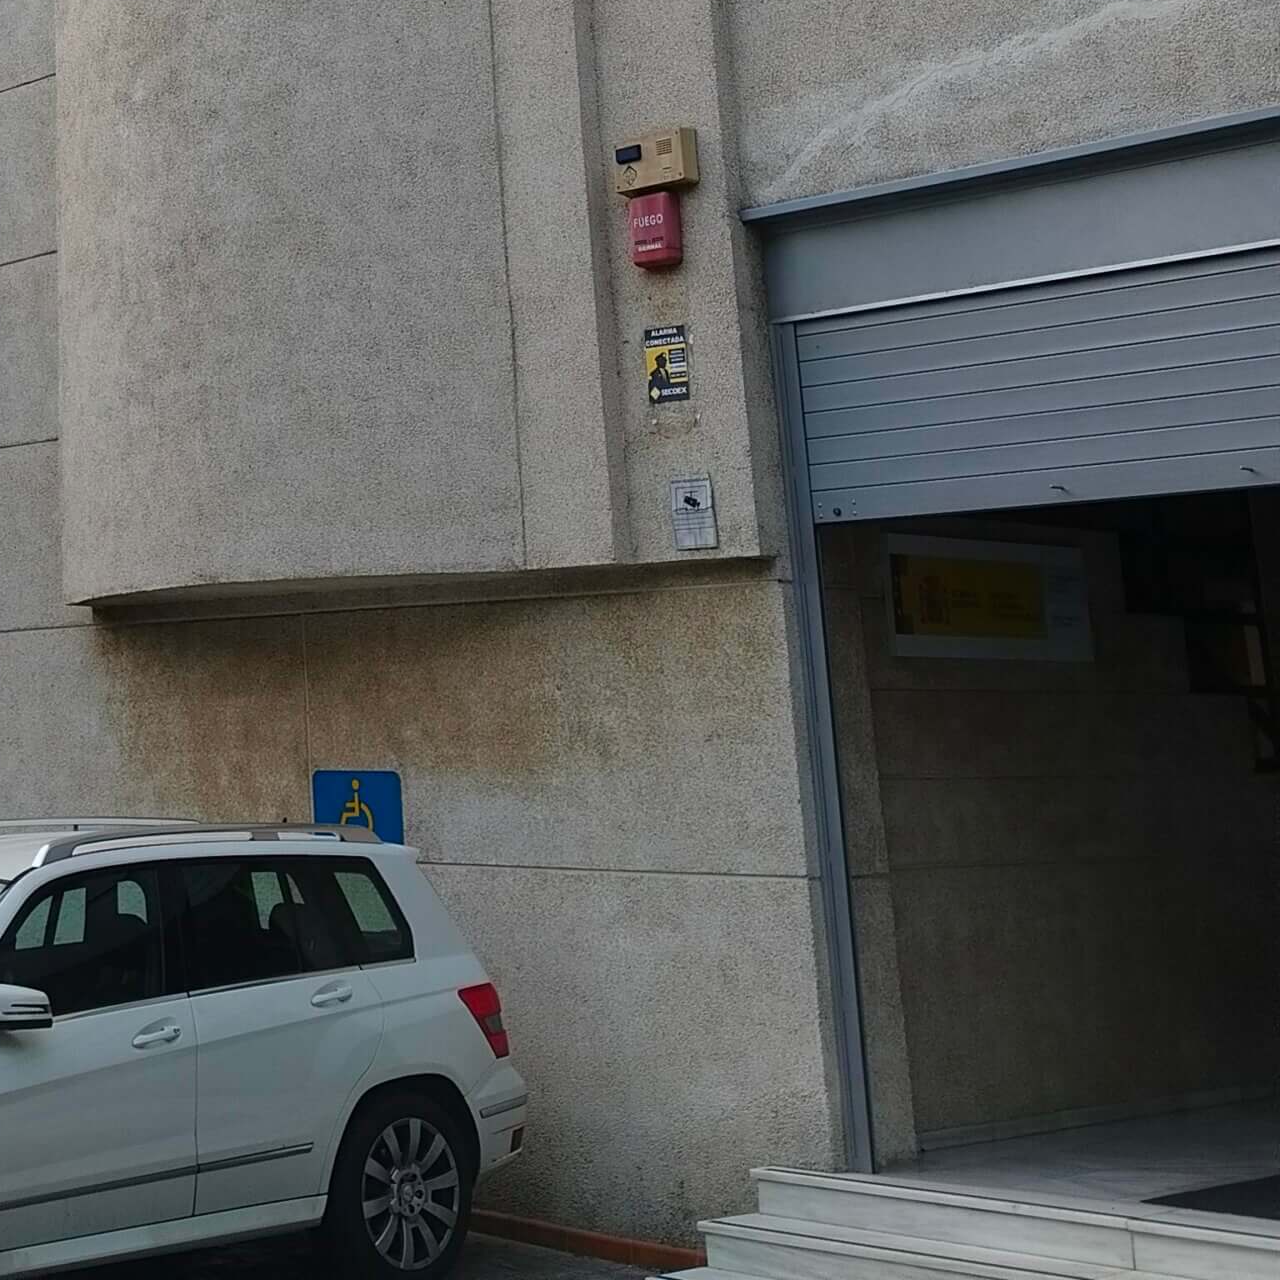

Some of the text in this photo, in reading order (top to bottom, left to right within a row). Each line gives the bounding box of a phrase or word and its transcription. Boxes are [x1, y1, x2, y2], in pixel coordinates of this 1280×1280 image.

[633, 213, 664, 228] FUEGO
[651, 327, 677, 337] ALARMA
[645, 335, 685, 347] CONECTADA
